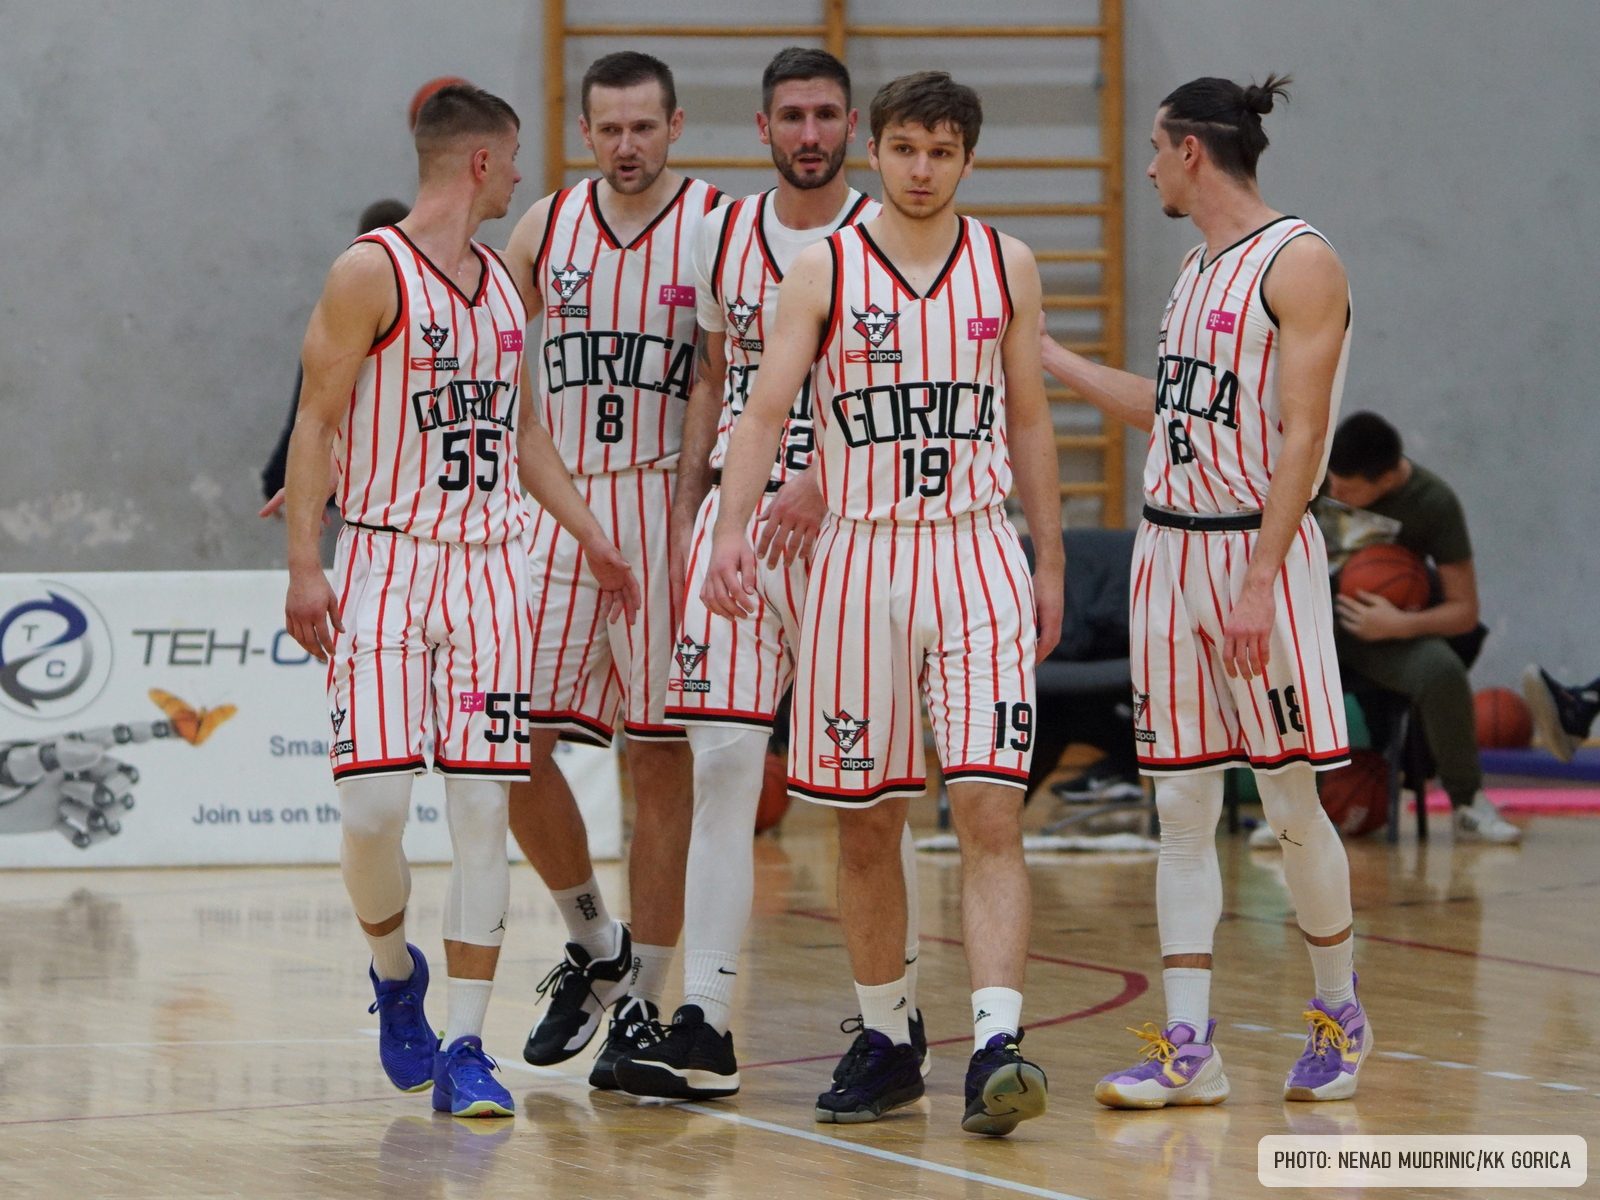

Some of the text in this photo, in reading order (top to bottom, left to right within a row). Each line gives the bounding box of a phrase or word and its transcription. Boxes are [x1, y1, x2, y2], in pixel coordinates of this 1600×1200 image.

[560, 305, 588, 317] alpas
[434, 358, 459, 371] alpas
[544, 331, 695, 402] GORICA
[868, 350, 901, 363] alpas
[596, 394, 624, 444] 8
[832, 382, 995, 448] GORICA
[775, 426, 814, 470] 2
[438, 429, 502, 492] 55
[903, 447, 949, 498] 19
[22, 625, 39, 642] T
[683, 681, 709, 691] alpas
[994, 701, 1033, 752] 19
[270, 736, 329, 756] Sma
[841, 759, 873, 771] alpas
[192, 804, 240, 824] Join
[248, 809, 273, 824] us
[280, 809, 309, 824] on
[416, 804, 439, 823] to
